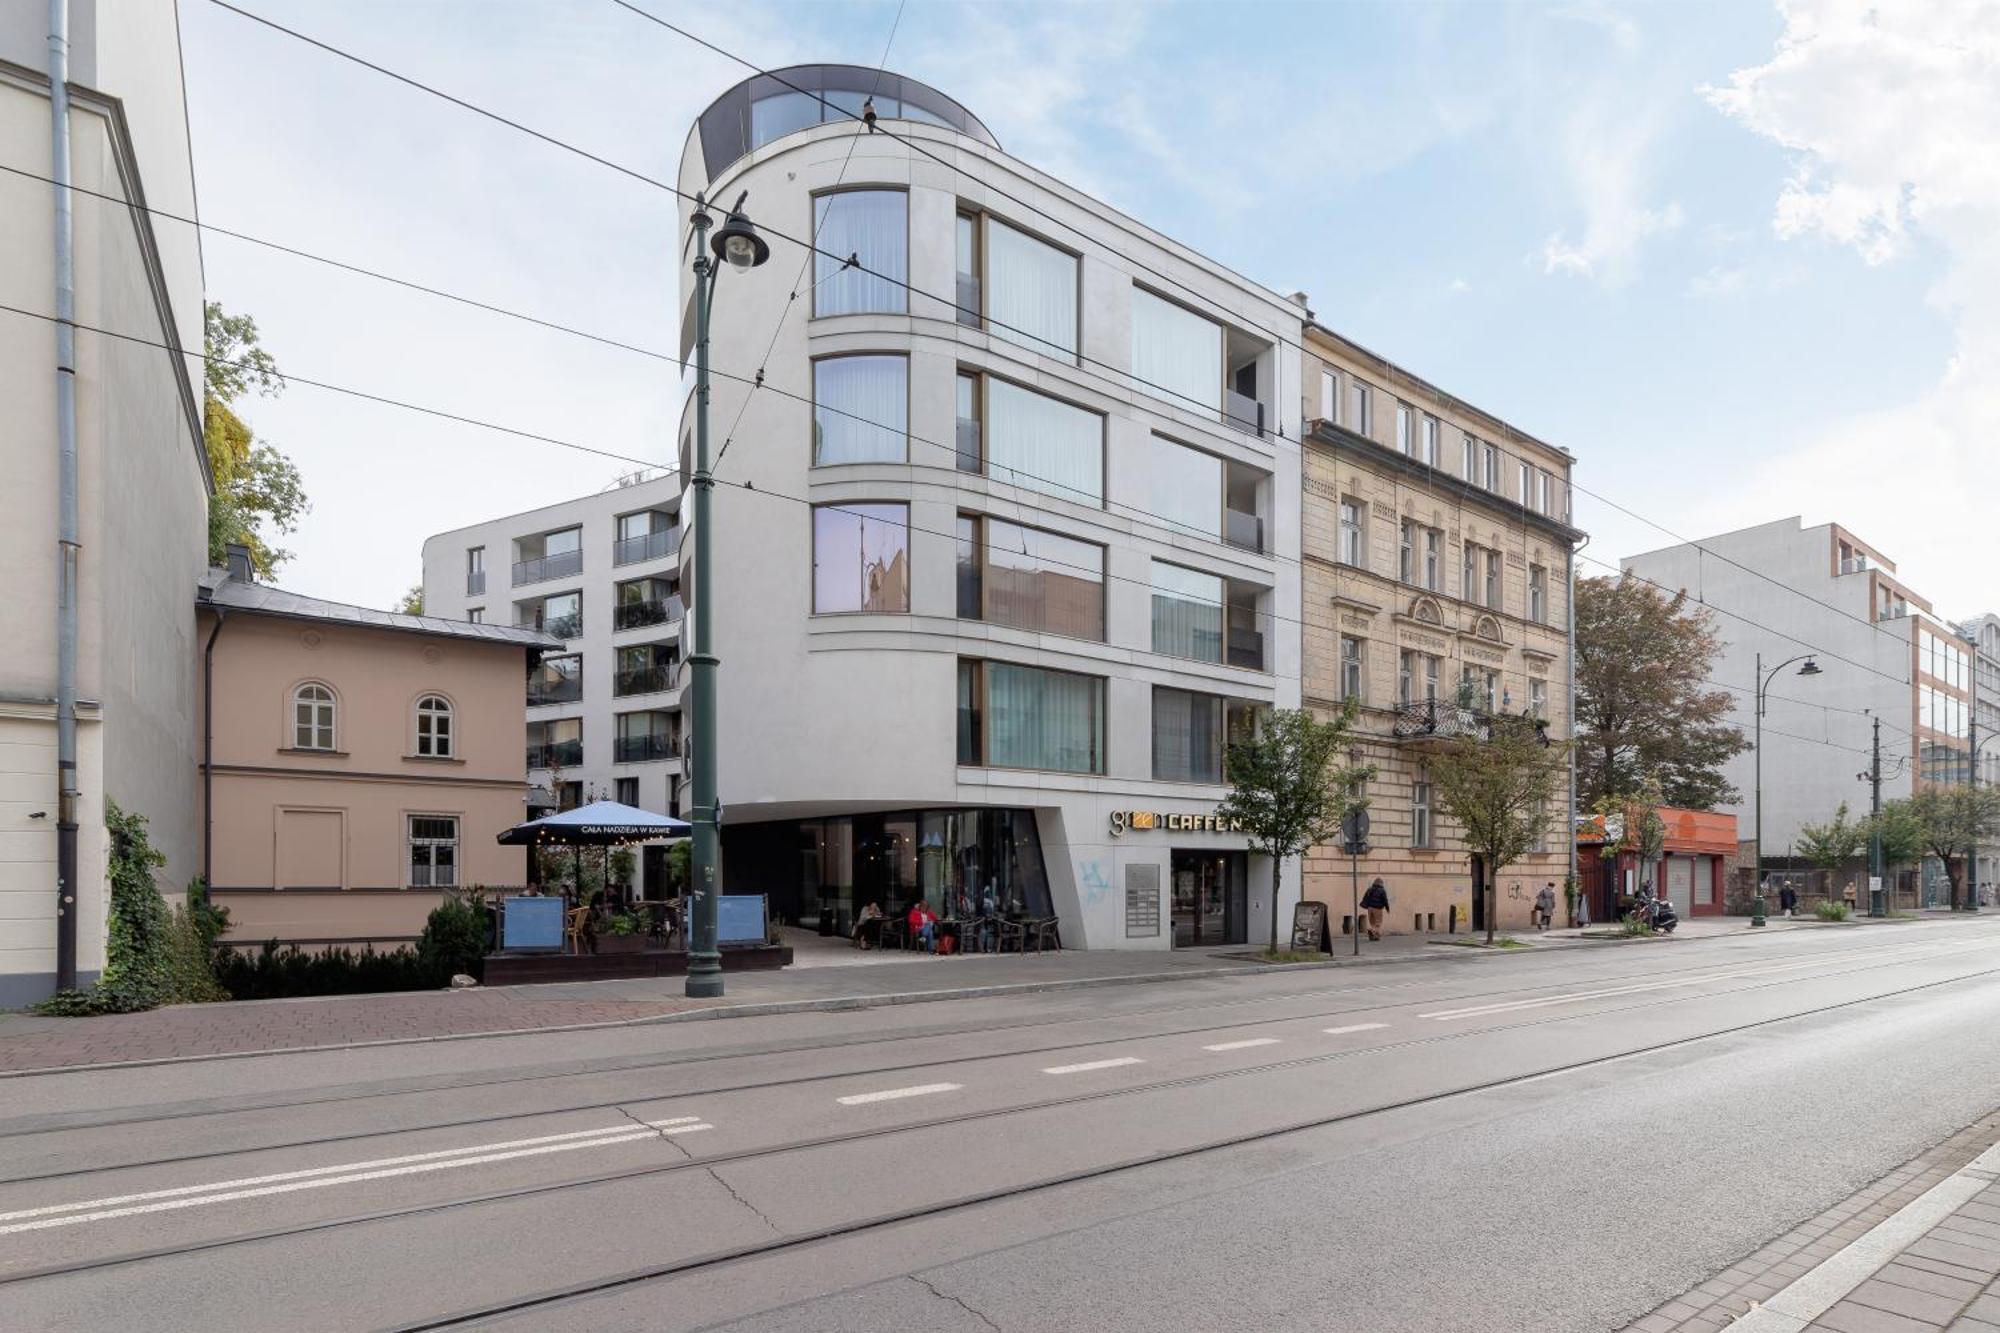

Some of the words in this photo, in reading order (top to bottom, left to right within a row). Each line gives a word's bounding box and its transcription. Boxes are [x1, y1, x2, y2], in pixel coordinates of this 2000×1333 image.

[603, 825, 639, 834] NADZIEJA
[640, 825, 648, 834] W
[1109, 810, 1162, 836] green
